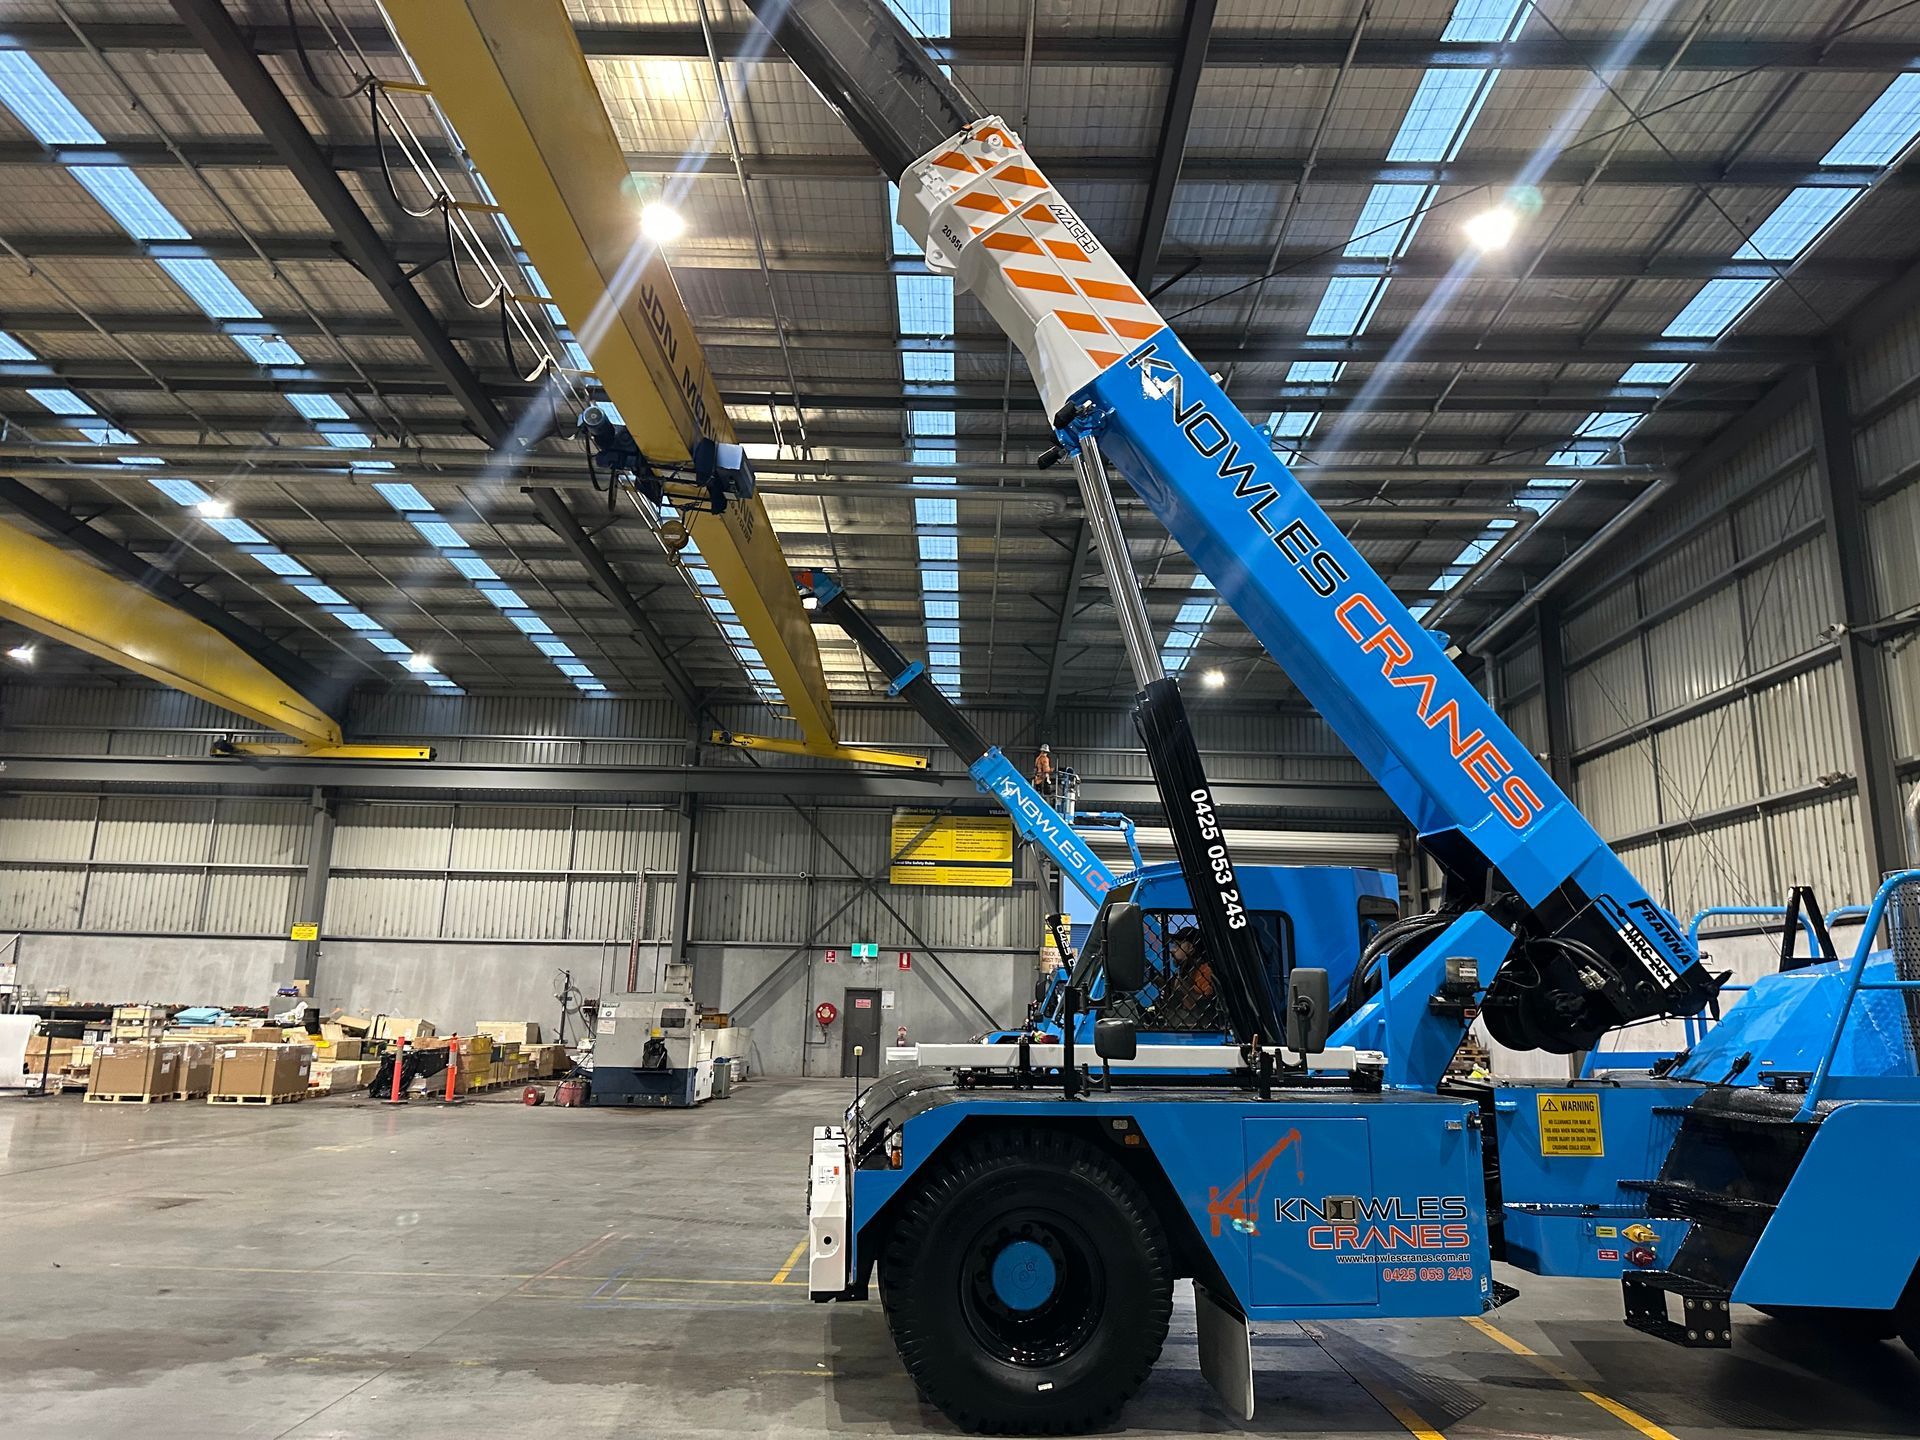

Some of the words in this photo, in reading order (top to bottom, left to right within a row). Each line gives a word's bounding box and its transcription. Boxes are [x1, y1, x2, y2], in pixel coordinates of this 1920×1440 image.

[942, 225, 962, 251] 20.95t
[1049, 205, 1099, 254] MAC25
[1127, 344, 1349, 597] KNOWLES
[1335, 593, 1544, 828] CRANES
[1000, 776, 1087, 869] KNOWLES
[1191, 789, 1220, 840] 0425
[1208, 845, 1233, 885] 053
[1221, 889, 1247, 929] 243
[1056, 925, 1072, 956] 0425
[1628, 899, 1692, 965] FRANNA
[1561, 1100, 1594, 1112] WARNING
[1275, 1196, 1467, 1223] KNWLES
[1308, 1224, 1470, 1250] CRANES
[1335, 1252, 1470, 1264] www.knowlescranes.com.au
[1383, 1268, 1416, 1282] 0425
[1420, 1267, 1445, 1281] 053
[1448, 1266, 1473, 1281] 243
